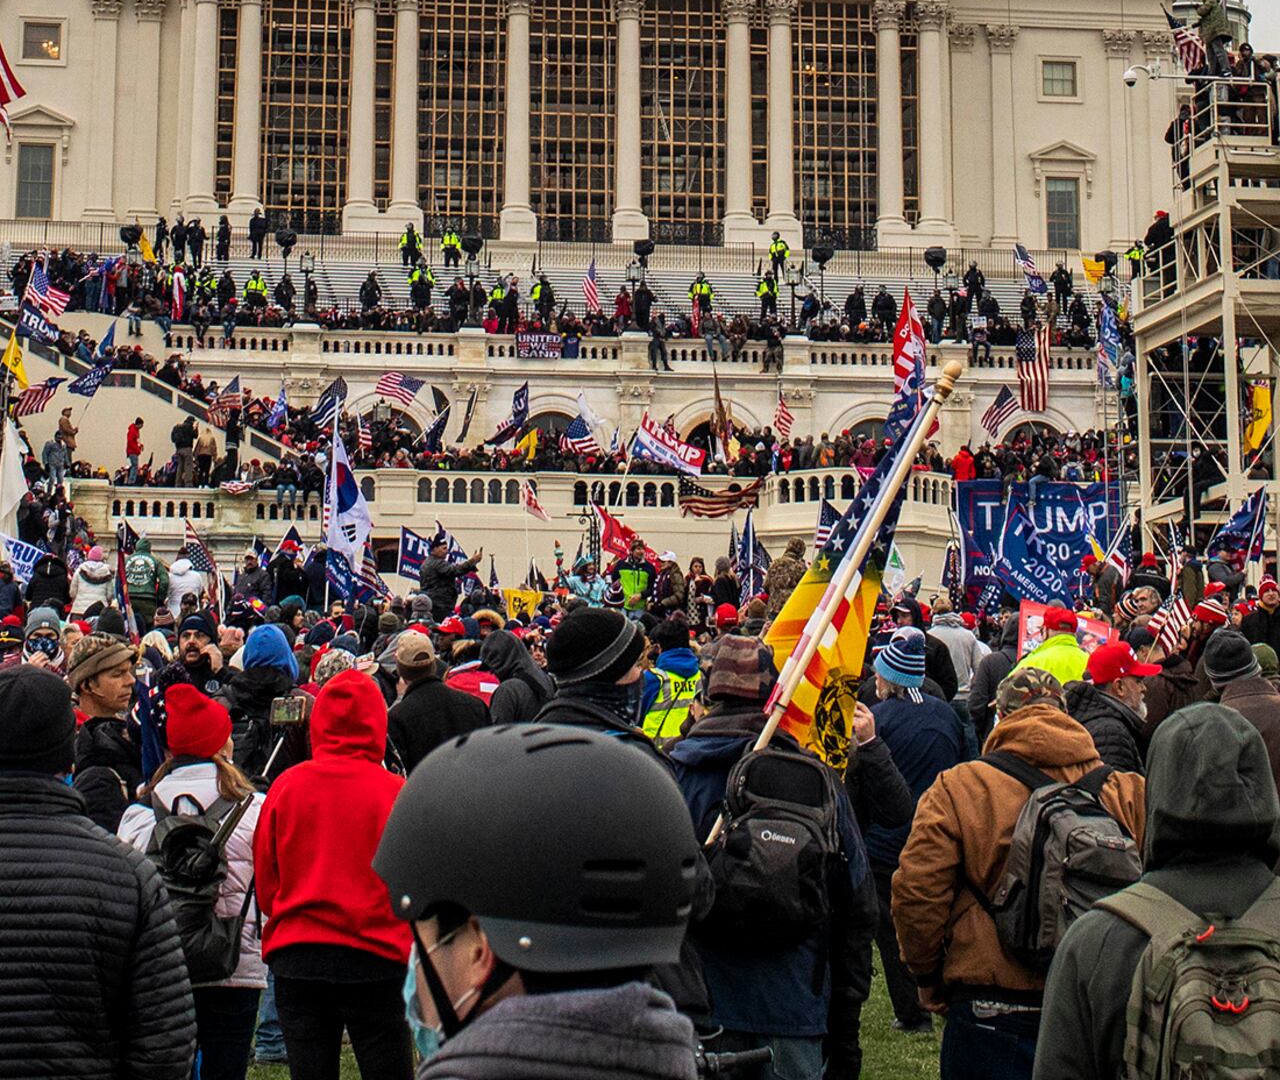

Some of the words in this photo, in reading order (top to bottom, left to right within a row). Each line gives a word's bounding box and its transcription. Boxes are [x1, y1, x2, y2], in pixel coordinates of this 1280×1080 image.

[518, 334, 561, 344] UNITED
[530, 342, 549, 351] WE
[976, 500, 1108, 534] TUMP
[405, 532, 431, 558] TR
[1011, 570, 1049, 603] AMERICA
